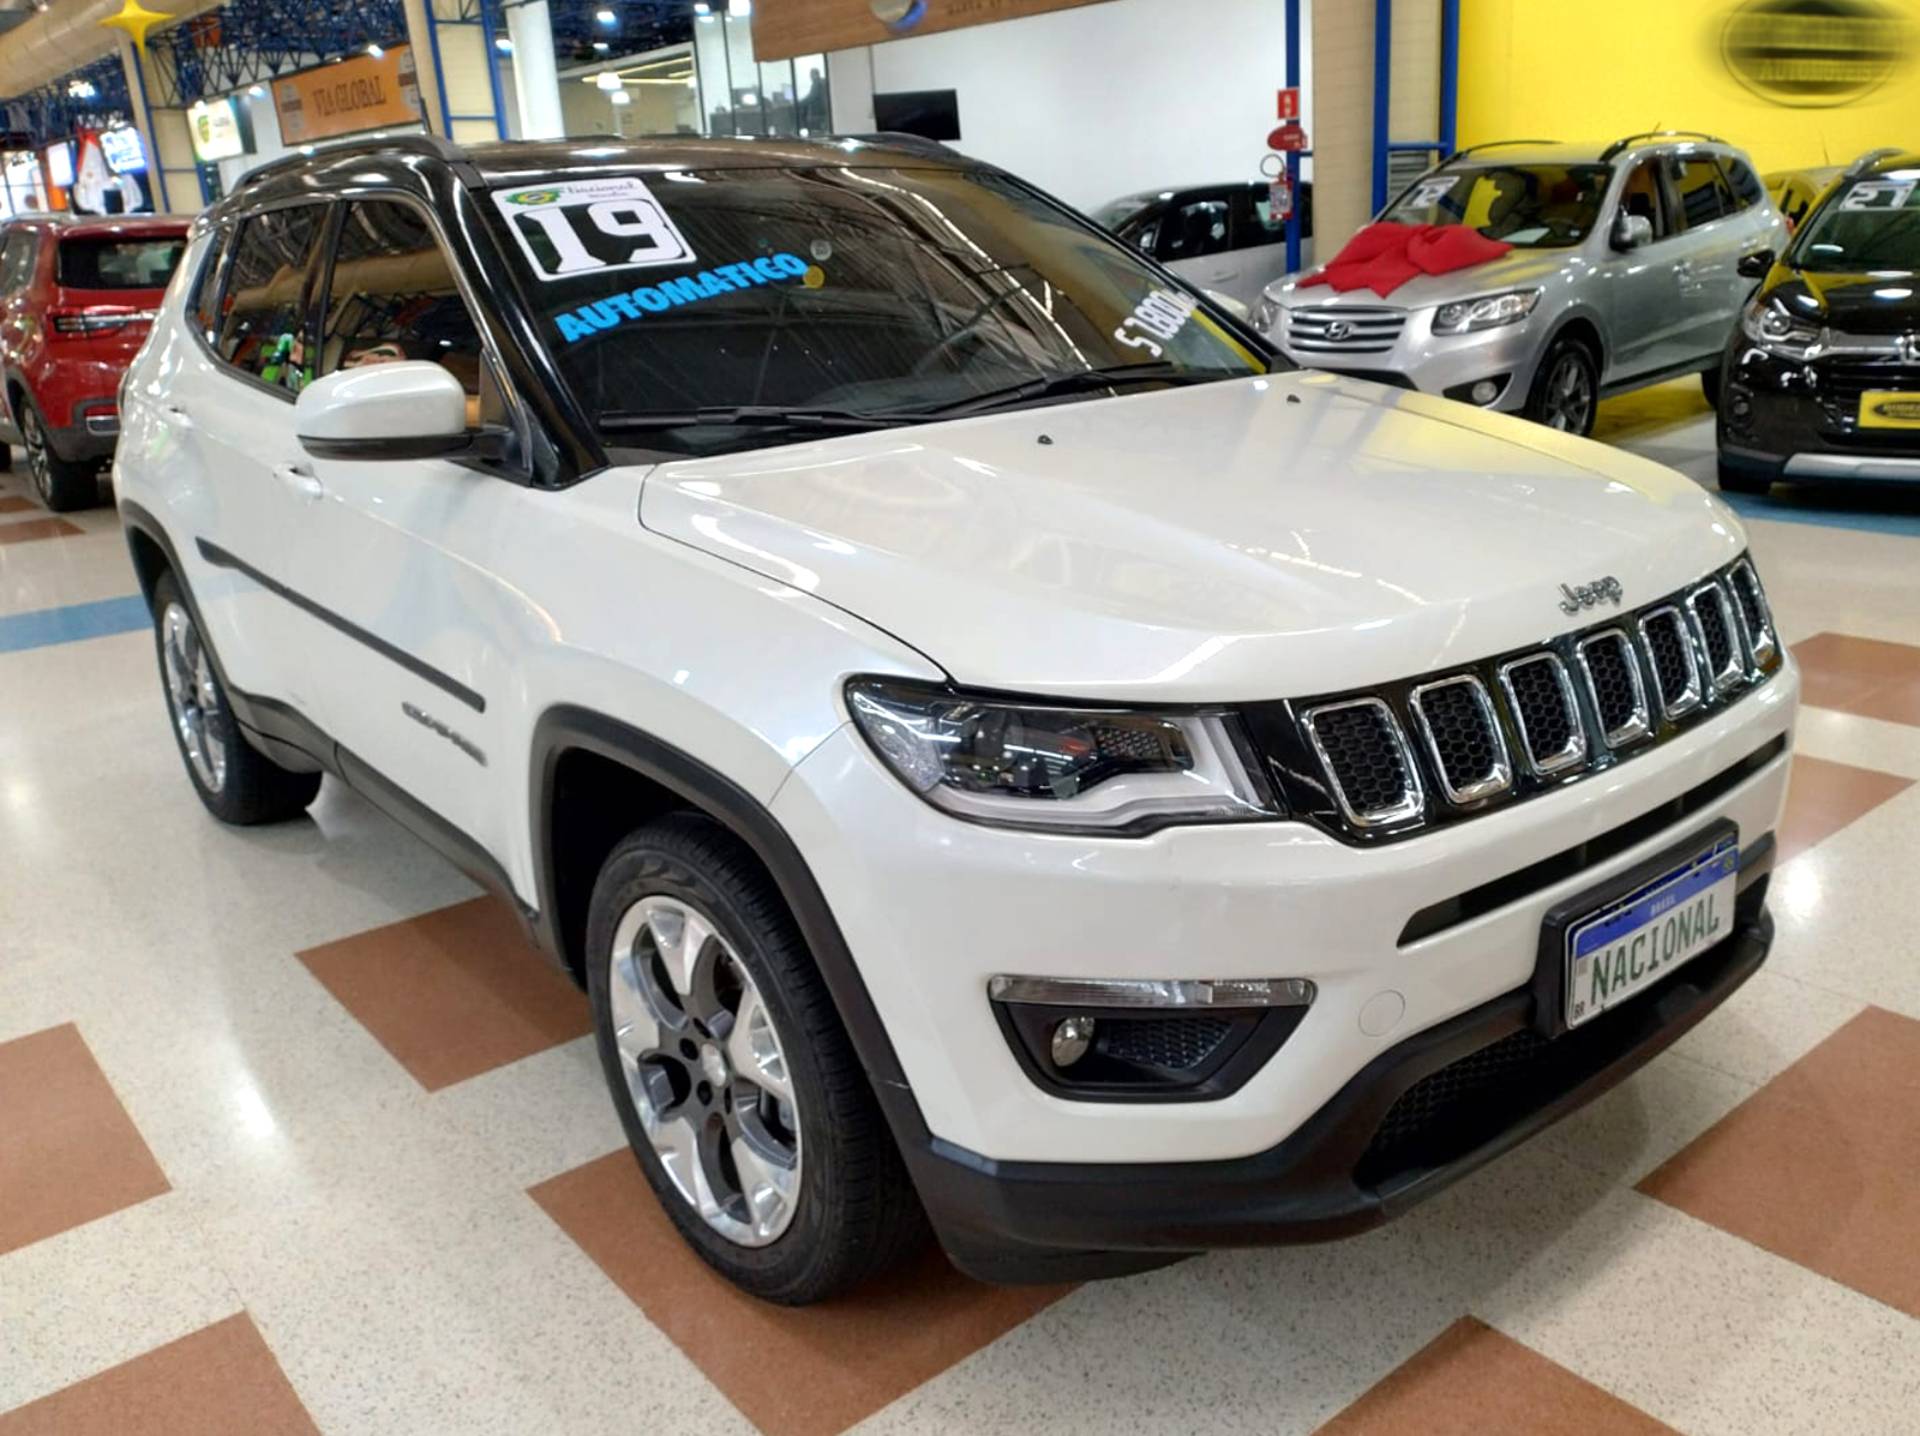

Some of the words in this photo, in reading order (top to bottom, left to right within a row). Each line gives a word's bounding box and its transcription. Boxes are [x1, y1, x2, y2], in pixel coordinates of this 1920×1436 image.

[312, 88, 336, 116] VIA
[335, 76, 387, 112] GLOBAL
[521, 199, 684, 274] 19
[554, 253, 809, 343] AUTOMATICO
[1558, 576, 1623, 613] Jeep
[1590, 894, 1720, 1006] NACIONAL
